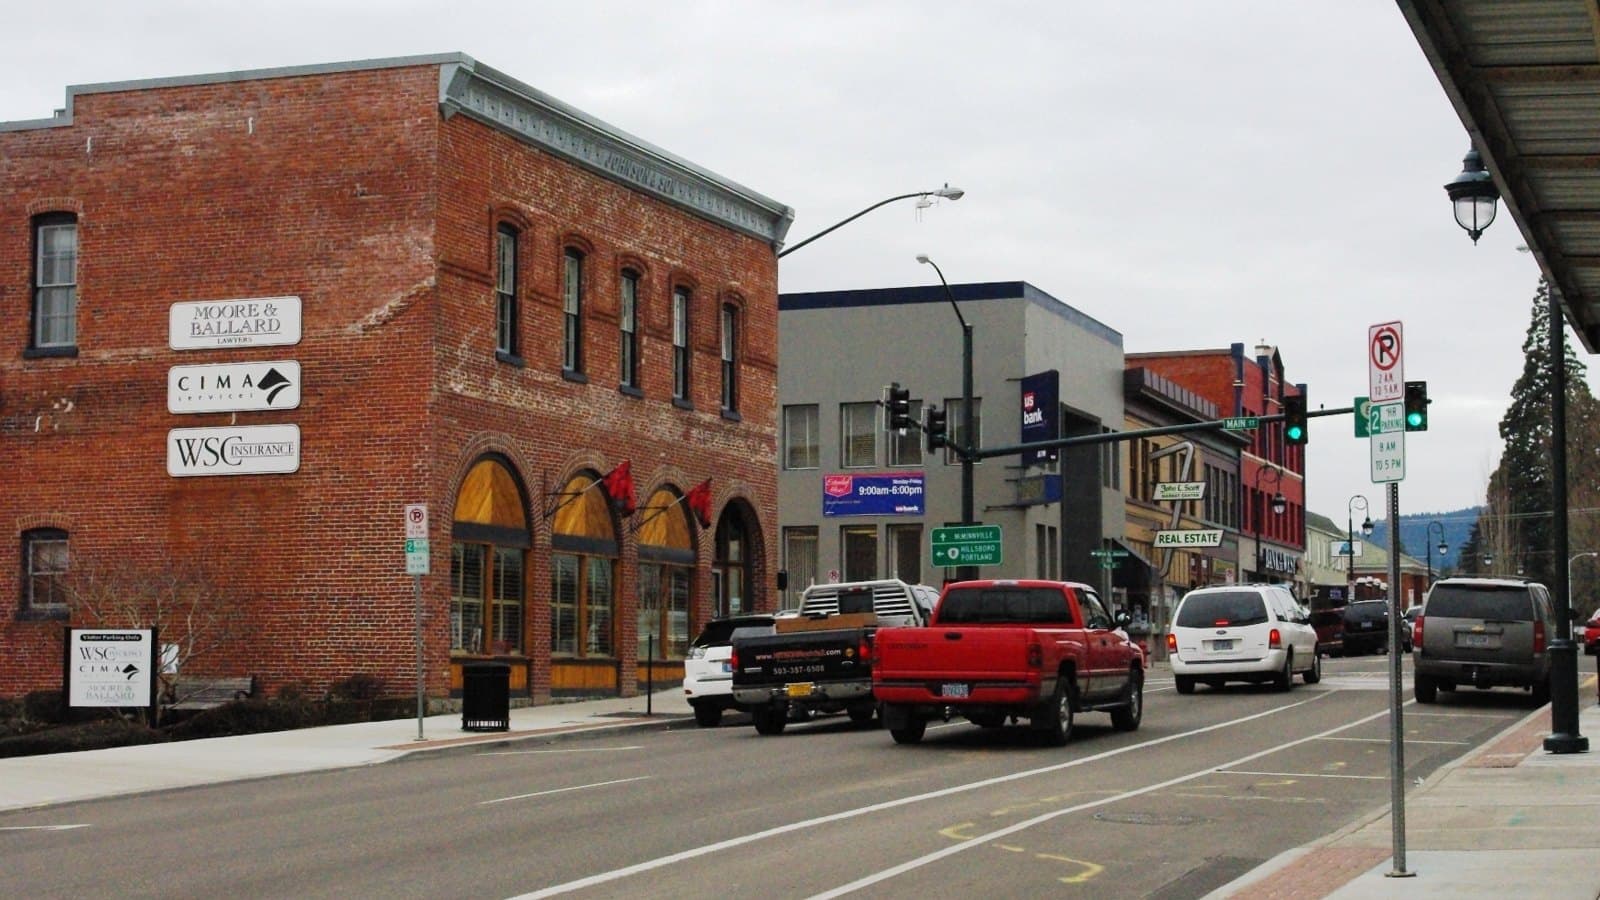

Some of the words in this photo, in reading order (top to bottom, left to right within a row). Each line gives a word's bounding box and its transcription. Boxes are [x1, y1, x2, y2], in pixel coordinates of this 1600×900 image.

[193, 303, 260, 320] MOORE
[263, 302, 278, 317] &
[191, 318, 281, 336] BALLARD
[178, 373, 253, 391] CIMA
[1384, 372, 1393, 383] AM
[1389, 384, 1399, 393] AM
[178, 393, 253, 401] services
[1024, 396, 1034, 408] us
[1023, 408, 1042, 424] bank
[1371, 410, 1380, 431] 2
[1226, 419, 1246, 429] MAIN
[1381, 418, 1403, 430] PARKING
[175, 436, 243, 467] WSC
[231, 443, 294, 456] INSURANCE
[1386, 441, 1396, 451] AM
[1375, 461, 1382, 471] TO
[1384, 460, 1390, 470] 5
[1391, 459, 1401, 469] PM
[858, 485, 922, 496] 9:00am-6:00pm
[1159, 534, 1181, 544] REAL
[1184, 533, 1218, 543] ESTATE
[960, 544, 996, 553] HILLSBORO
[960, 553, 993, 561] PORTLAND
[80, 646, 116, 661] WSC
[79, 664, 120, 673] CIMA
